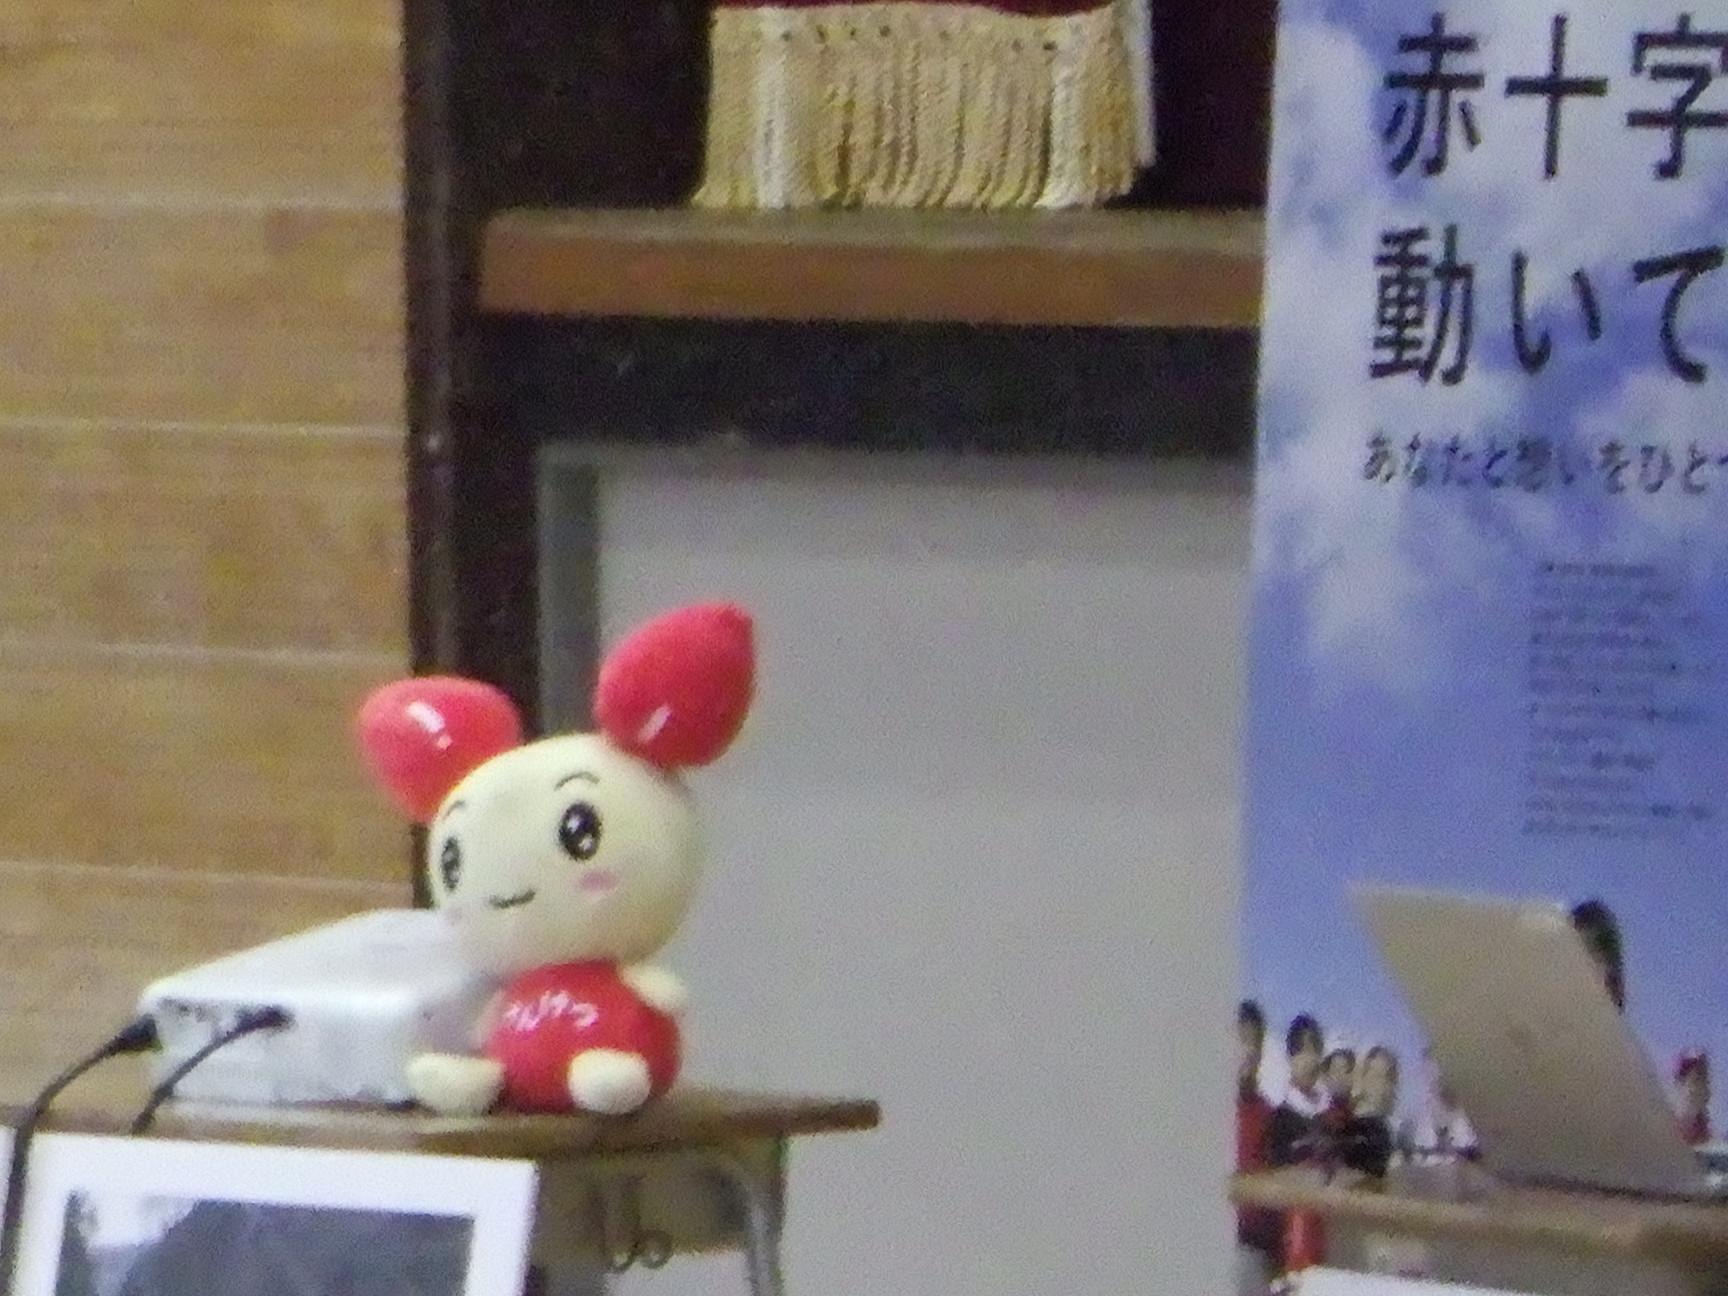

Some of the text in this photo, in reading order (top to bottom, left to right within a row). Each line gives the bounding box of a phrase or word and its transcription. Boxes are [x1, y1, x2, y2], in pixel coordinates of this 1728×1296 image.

[1382, 10, 1728, 181] 赤十字
[1369, 223, 1728, 387] 動いて
[1362, 430, 1728, 496] あなたと想いをひと
